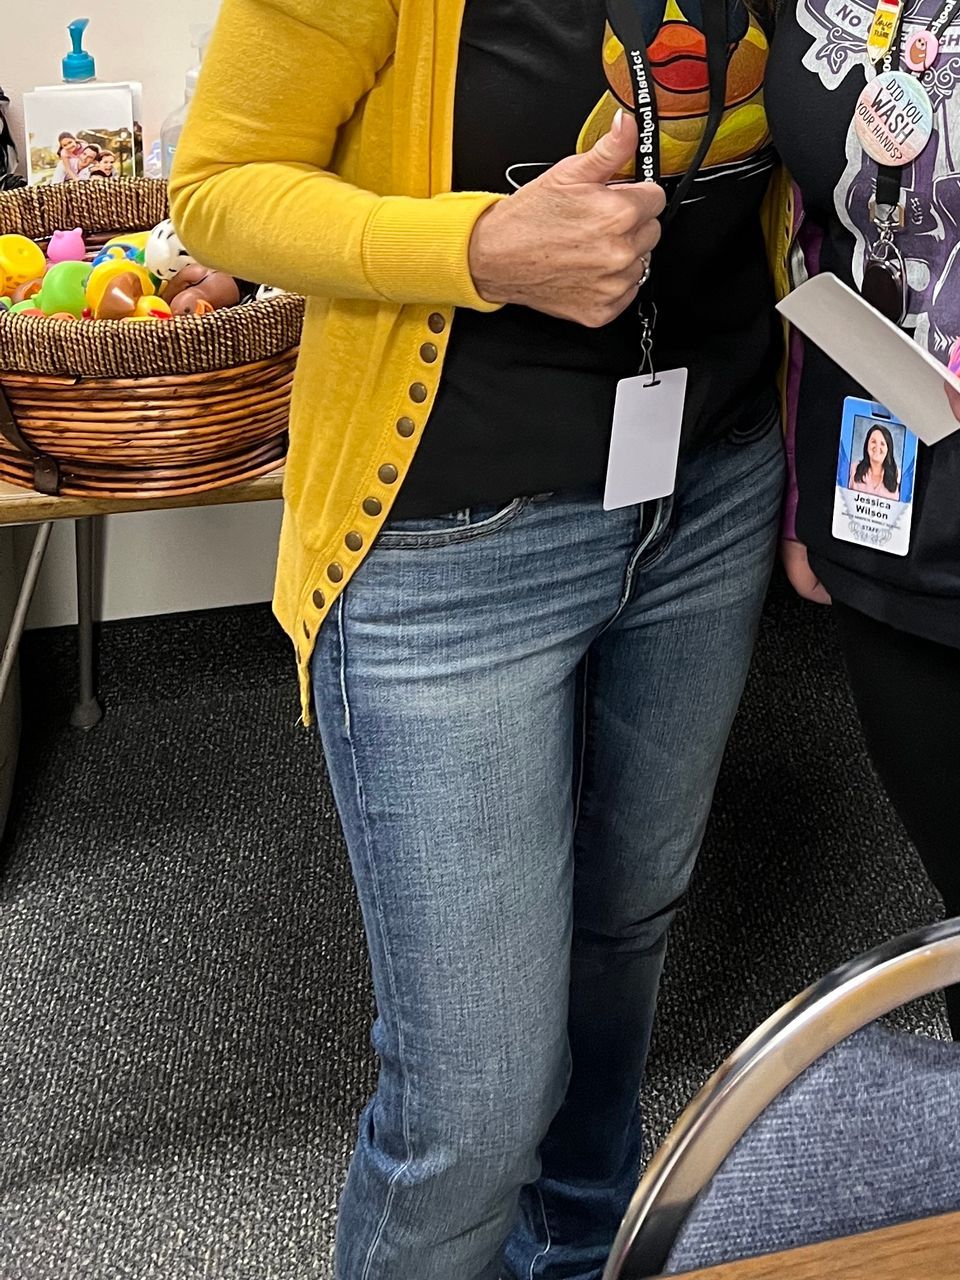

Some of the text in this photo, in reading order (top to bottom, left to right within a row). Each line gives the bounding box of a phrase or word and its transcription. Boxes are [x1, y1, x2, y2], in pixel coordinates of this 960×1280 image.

[836, 3, 861, 27] NO
[631, 50, 655, 153] School District
[871, 87, 915, 147] WASH
[886, 79, 904, 102] DID
[902, 99, 924, 126] YOU
[857, 101, 904, 161] YOUR HANDS?
[854, 494, 891, 510] Jessica
[856, 505, 888, 520] Wilson
[862, 524, 879, 533] STAFF
